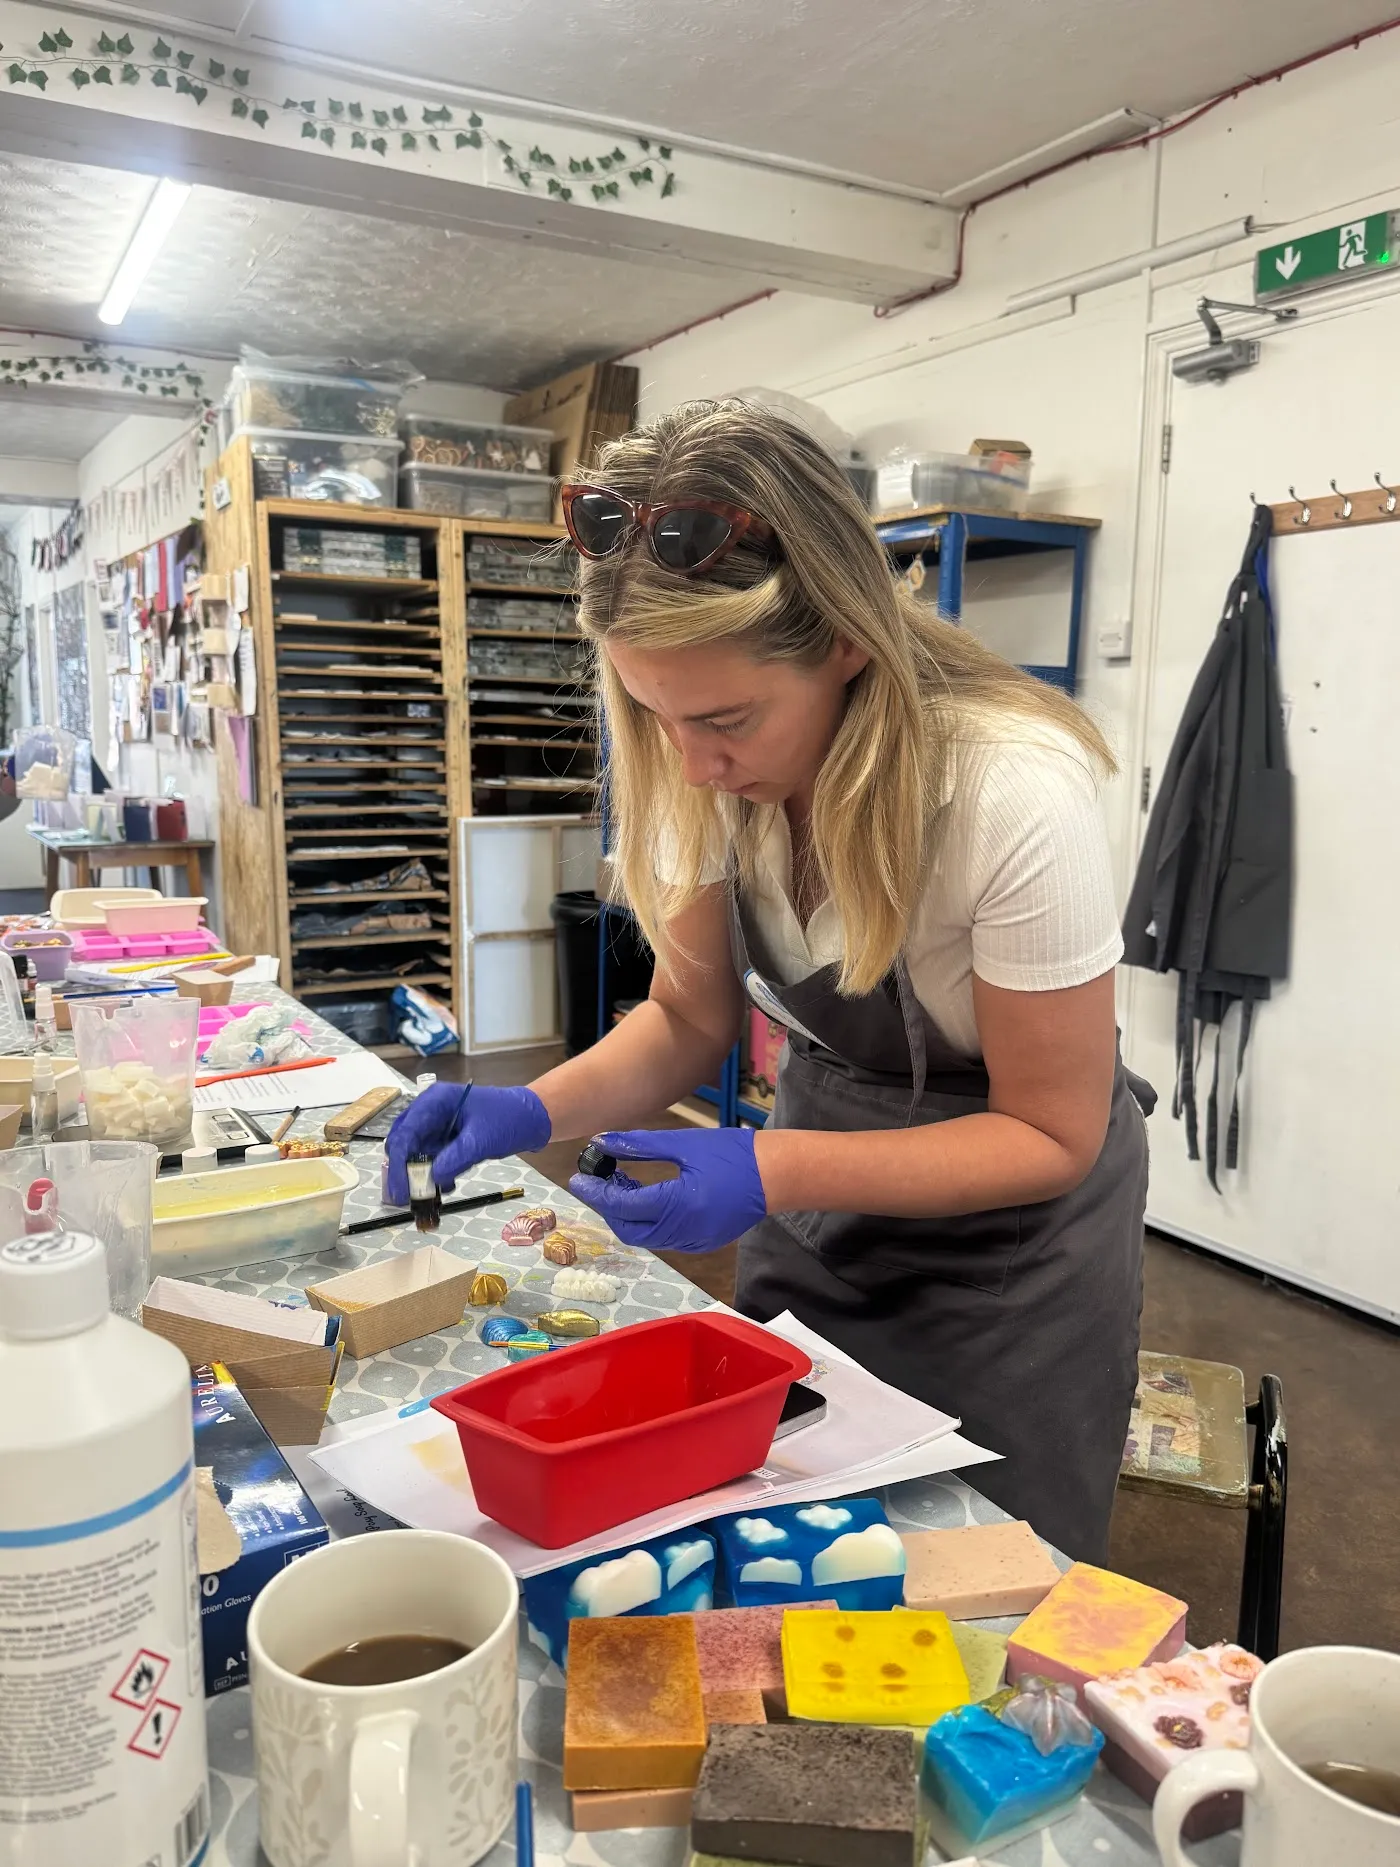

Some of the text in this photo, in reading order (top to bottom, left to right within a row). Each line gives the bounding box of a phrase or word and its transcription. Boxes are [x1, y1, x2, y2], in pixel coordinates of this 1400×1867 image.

[195, 1364, 236, 1424] AURELIA
[353, 1502, 367, 1517] Soap
[200, 1594, 252, 1616] ation Gloves
